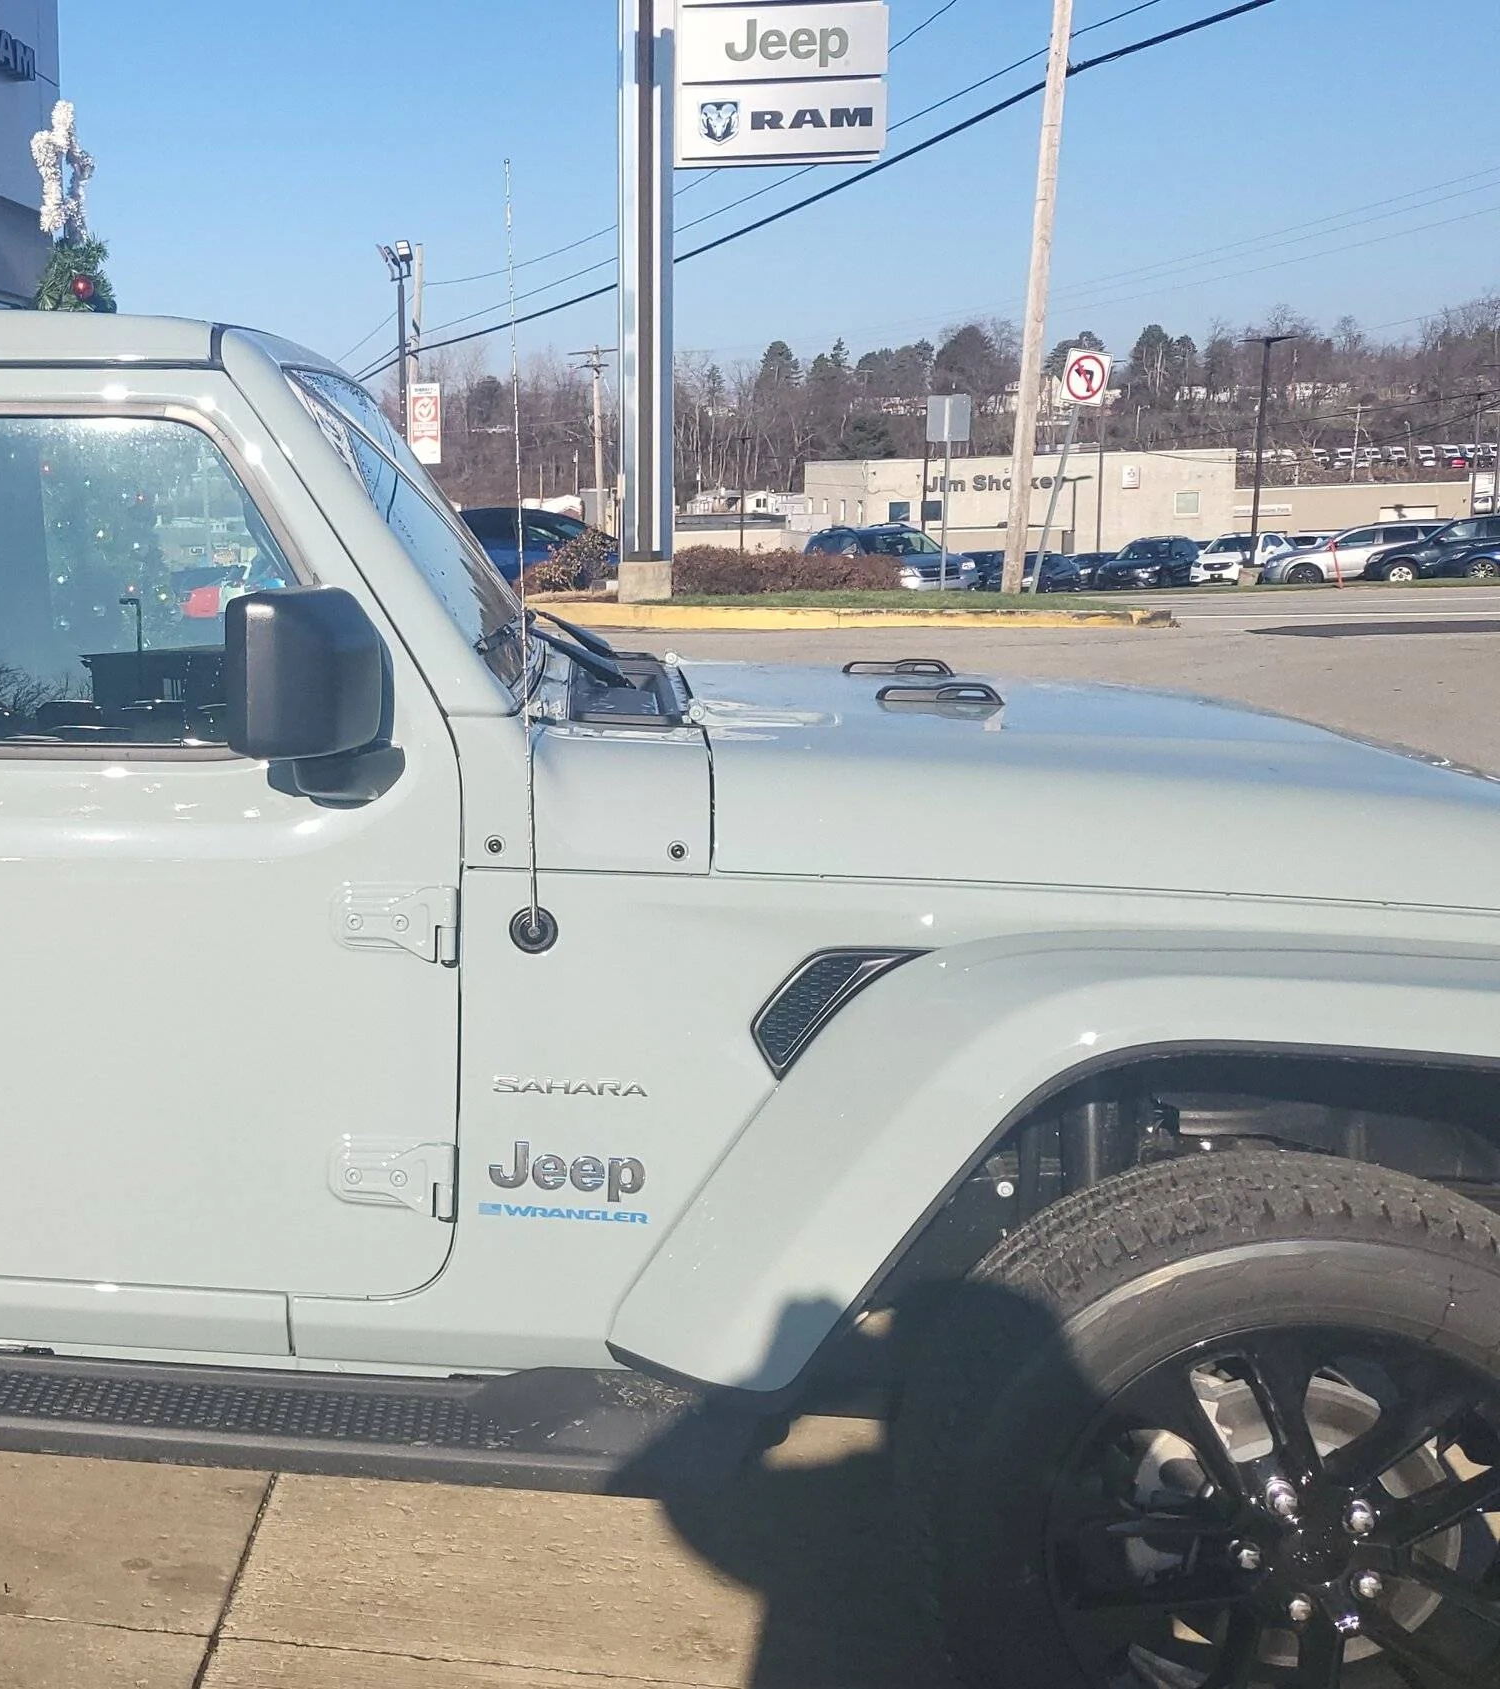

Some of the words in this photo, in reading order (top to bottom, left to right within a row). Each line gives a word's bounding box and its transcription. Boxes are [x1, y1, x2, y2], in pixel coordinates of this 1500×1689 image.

[725, 18, 849, 68] Jeep
[750, 106, 873, 131] RAM
[925, 475, 966, 493] Jim
[492, 1074, 648, 1097] SAHARA
[488, 1140, 646, 1203] Jeep
[504, 1204, 649, 1224] WRANGLER
